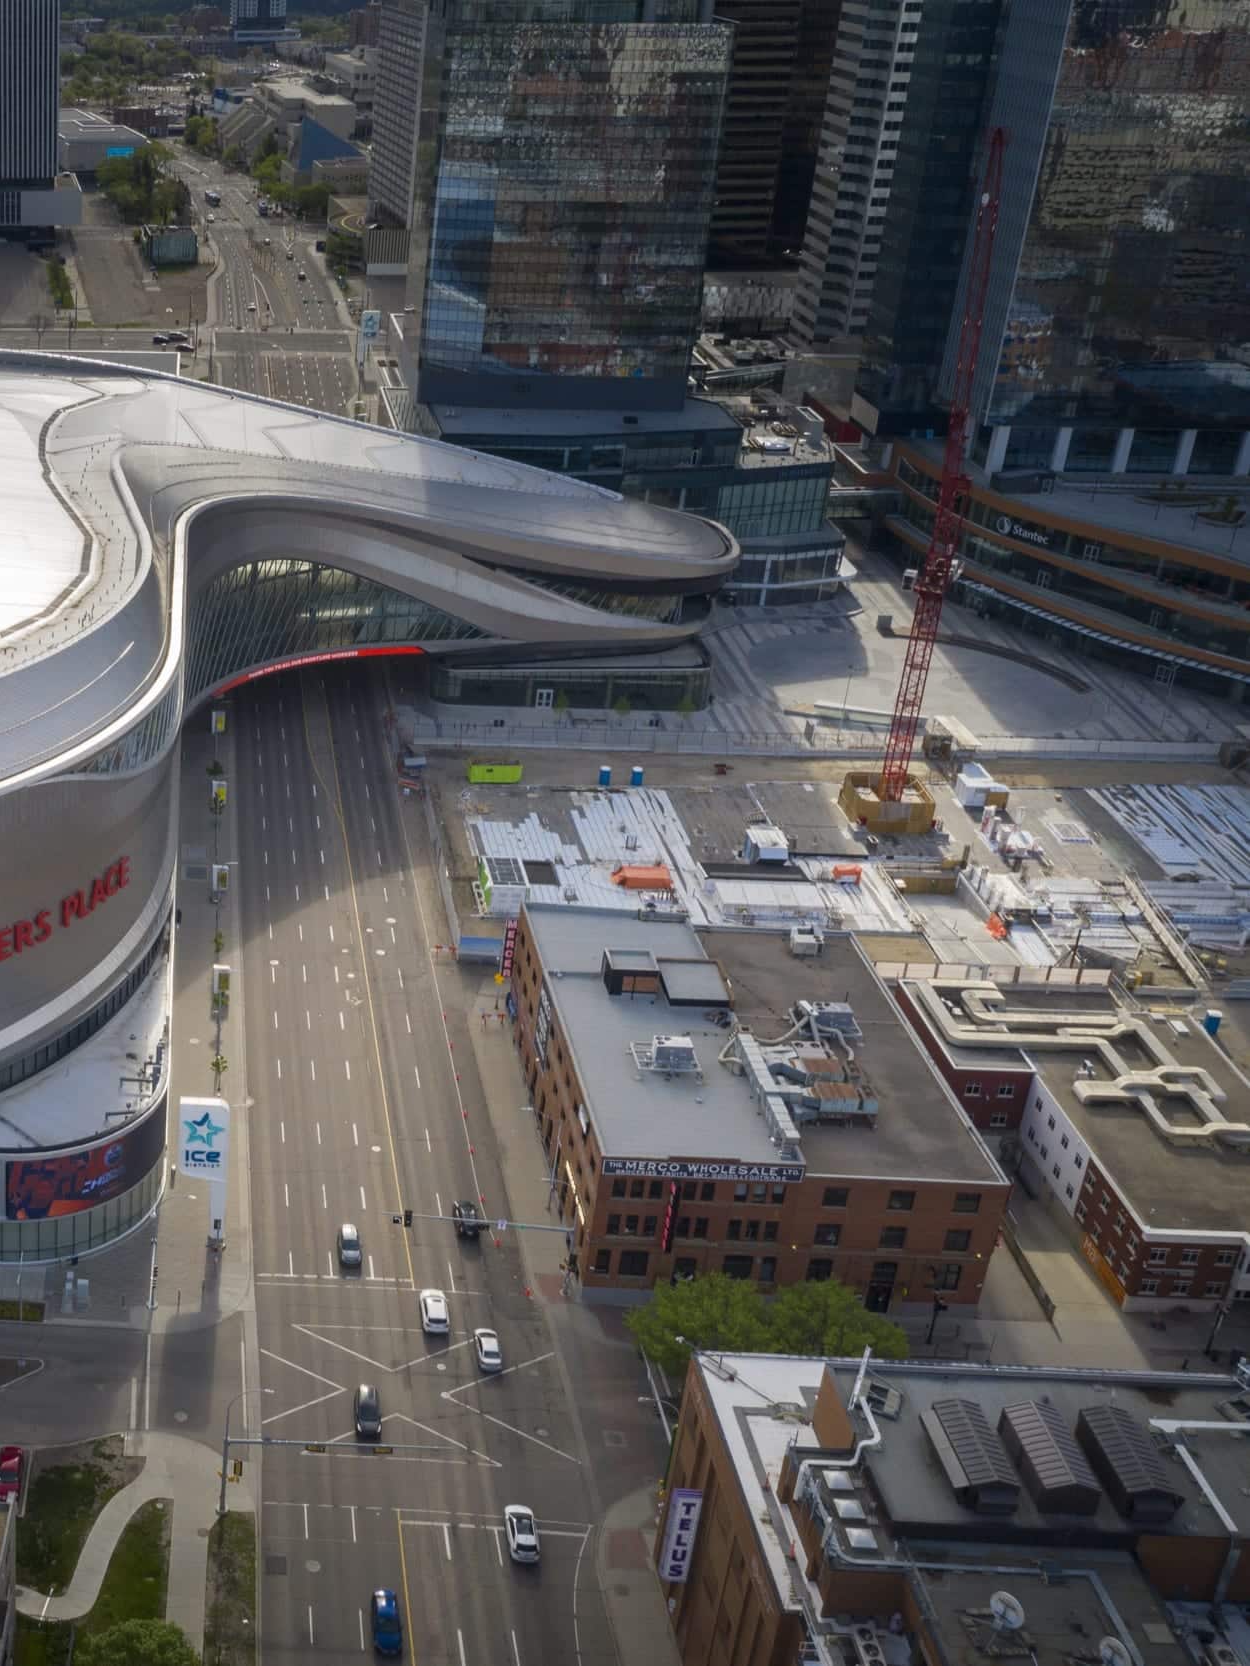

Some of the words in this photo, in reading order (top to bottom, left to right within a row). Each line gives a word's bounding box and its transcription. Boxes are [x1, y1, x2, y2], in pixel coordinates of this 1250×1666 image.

[1012, 524, 1049, 545] Stantec
[59, 855, 131, 928] PLACE
[625, 1160, 680, 1172] MERCO
[687, 1163, 779, 1177] WHOLESALE
[668, 1502, 697, 1577] TELUS
